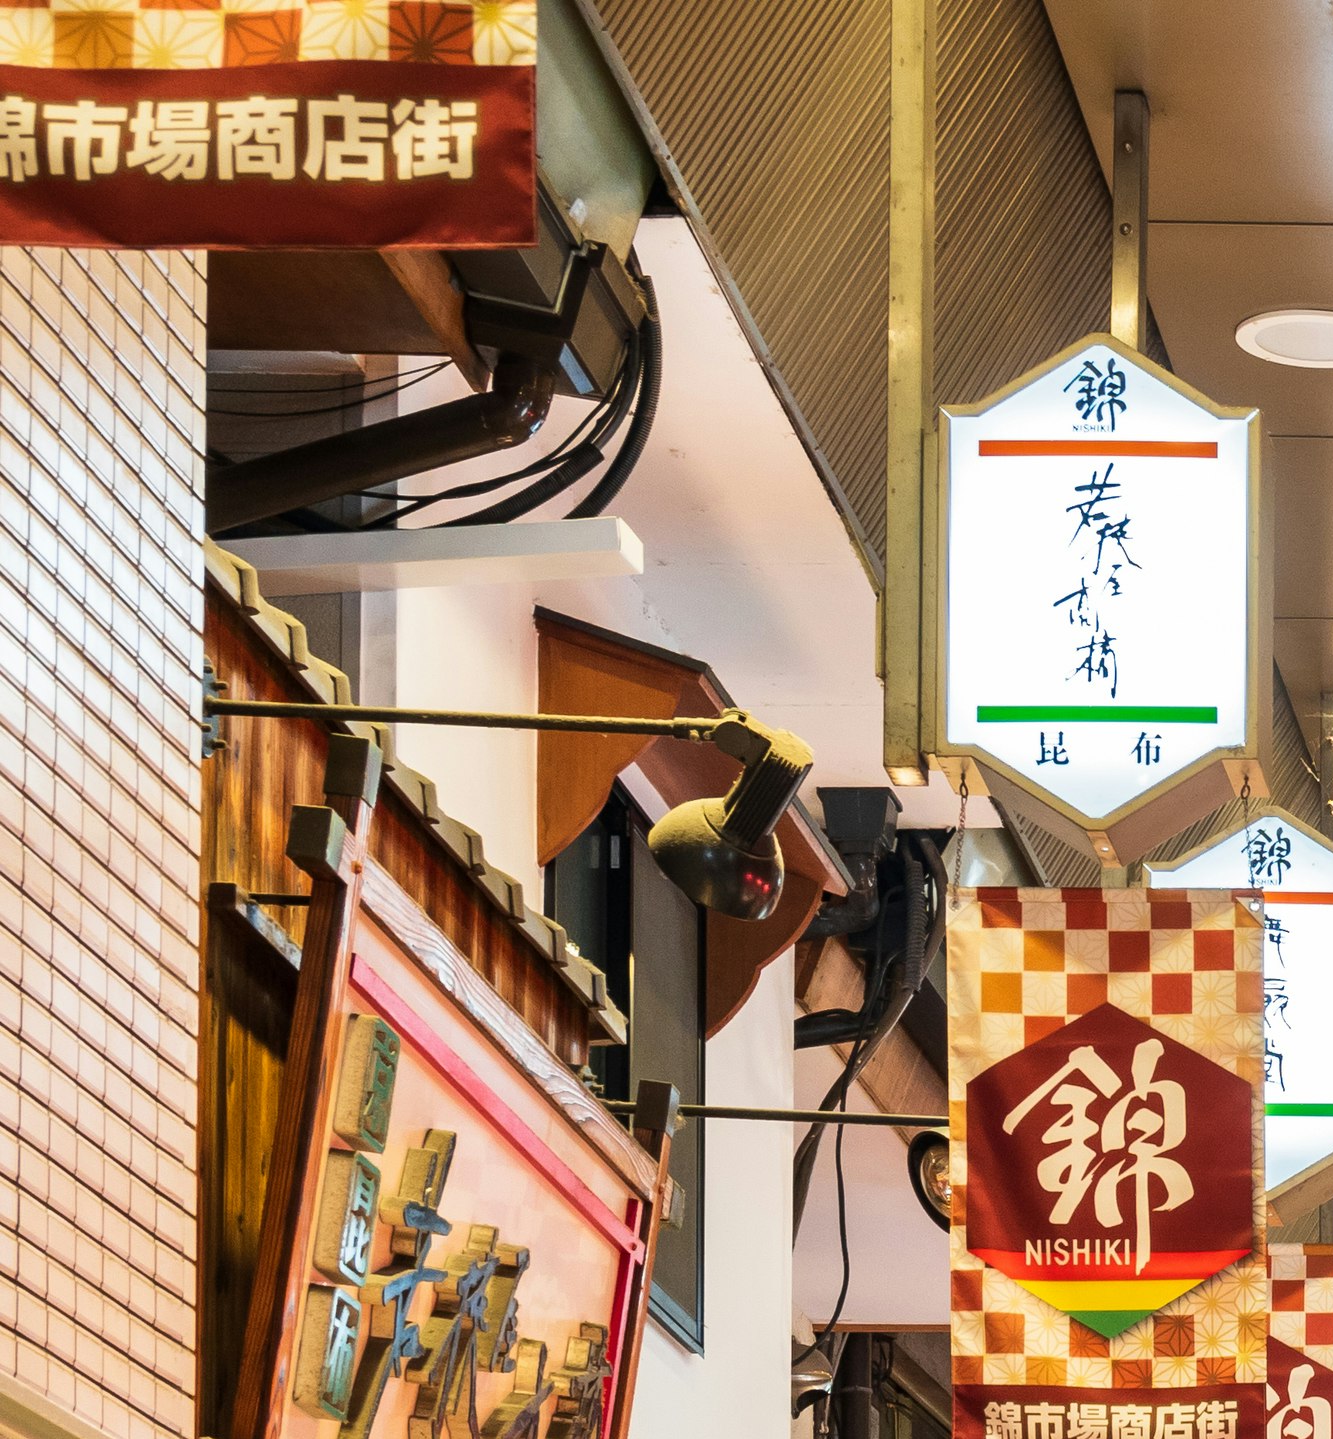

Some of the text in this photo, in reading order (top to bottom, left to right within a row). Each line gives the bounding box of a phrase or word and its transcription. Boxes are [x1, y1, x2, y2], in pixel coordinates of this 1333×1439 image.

[1064, 358, 1128, 433] 錦
[1035, 731, 1162, 767] 昆布
[1249, 826, 1292, 885] 錦
[1002, 1038, 1196, 1276] 錦
[1024, 1239, 1131, 1266] NISHIKI
